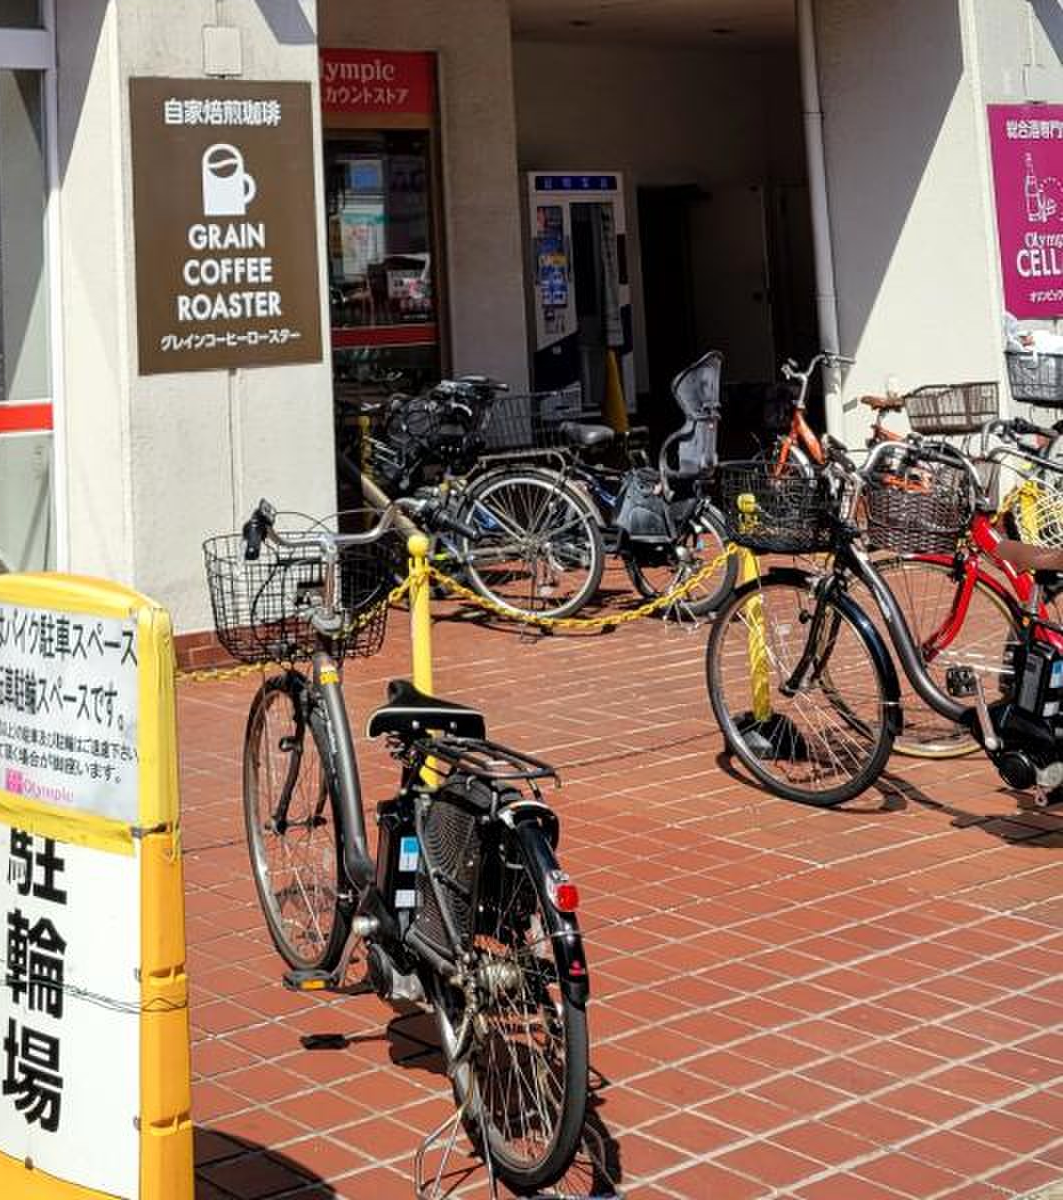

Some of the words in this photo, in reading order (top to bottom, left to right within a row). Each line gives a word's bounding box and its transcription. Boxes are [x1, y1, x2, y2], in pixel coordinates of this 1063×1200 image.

[163, 98, 282, 127] 自家焙煎珈琲
[188, 223, 266, 250] GRAIN
[182, 257, 273, 286] COFFEE
[177, 291, 282, 321] ROASTER
[159, 328, 301, 351] グレインコーヒーロースター
[2, 826, 68, 1133] 駐輪場
